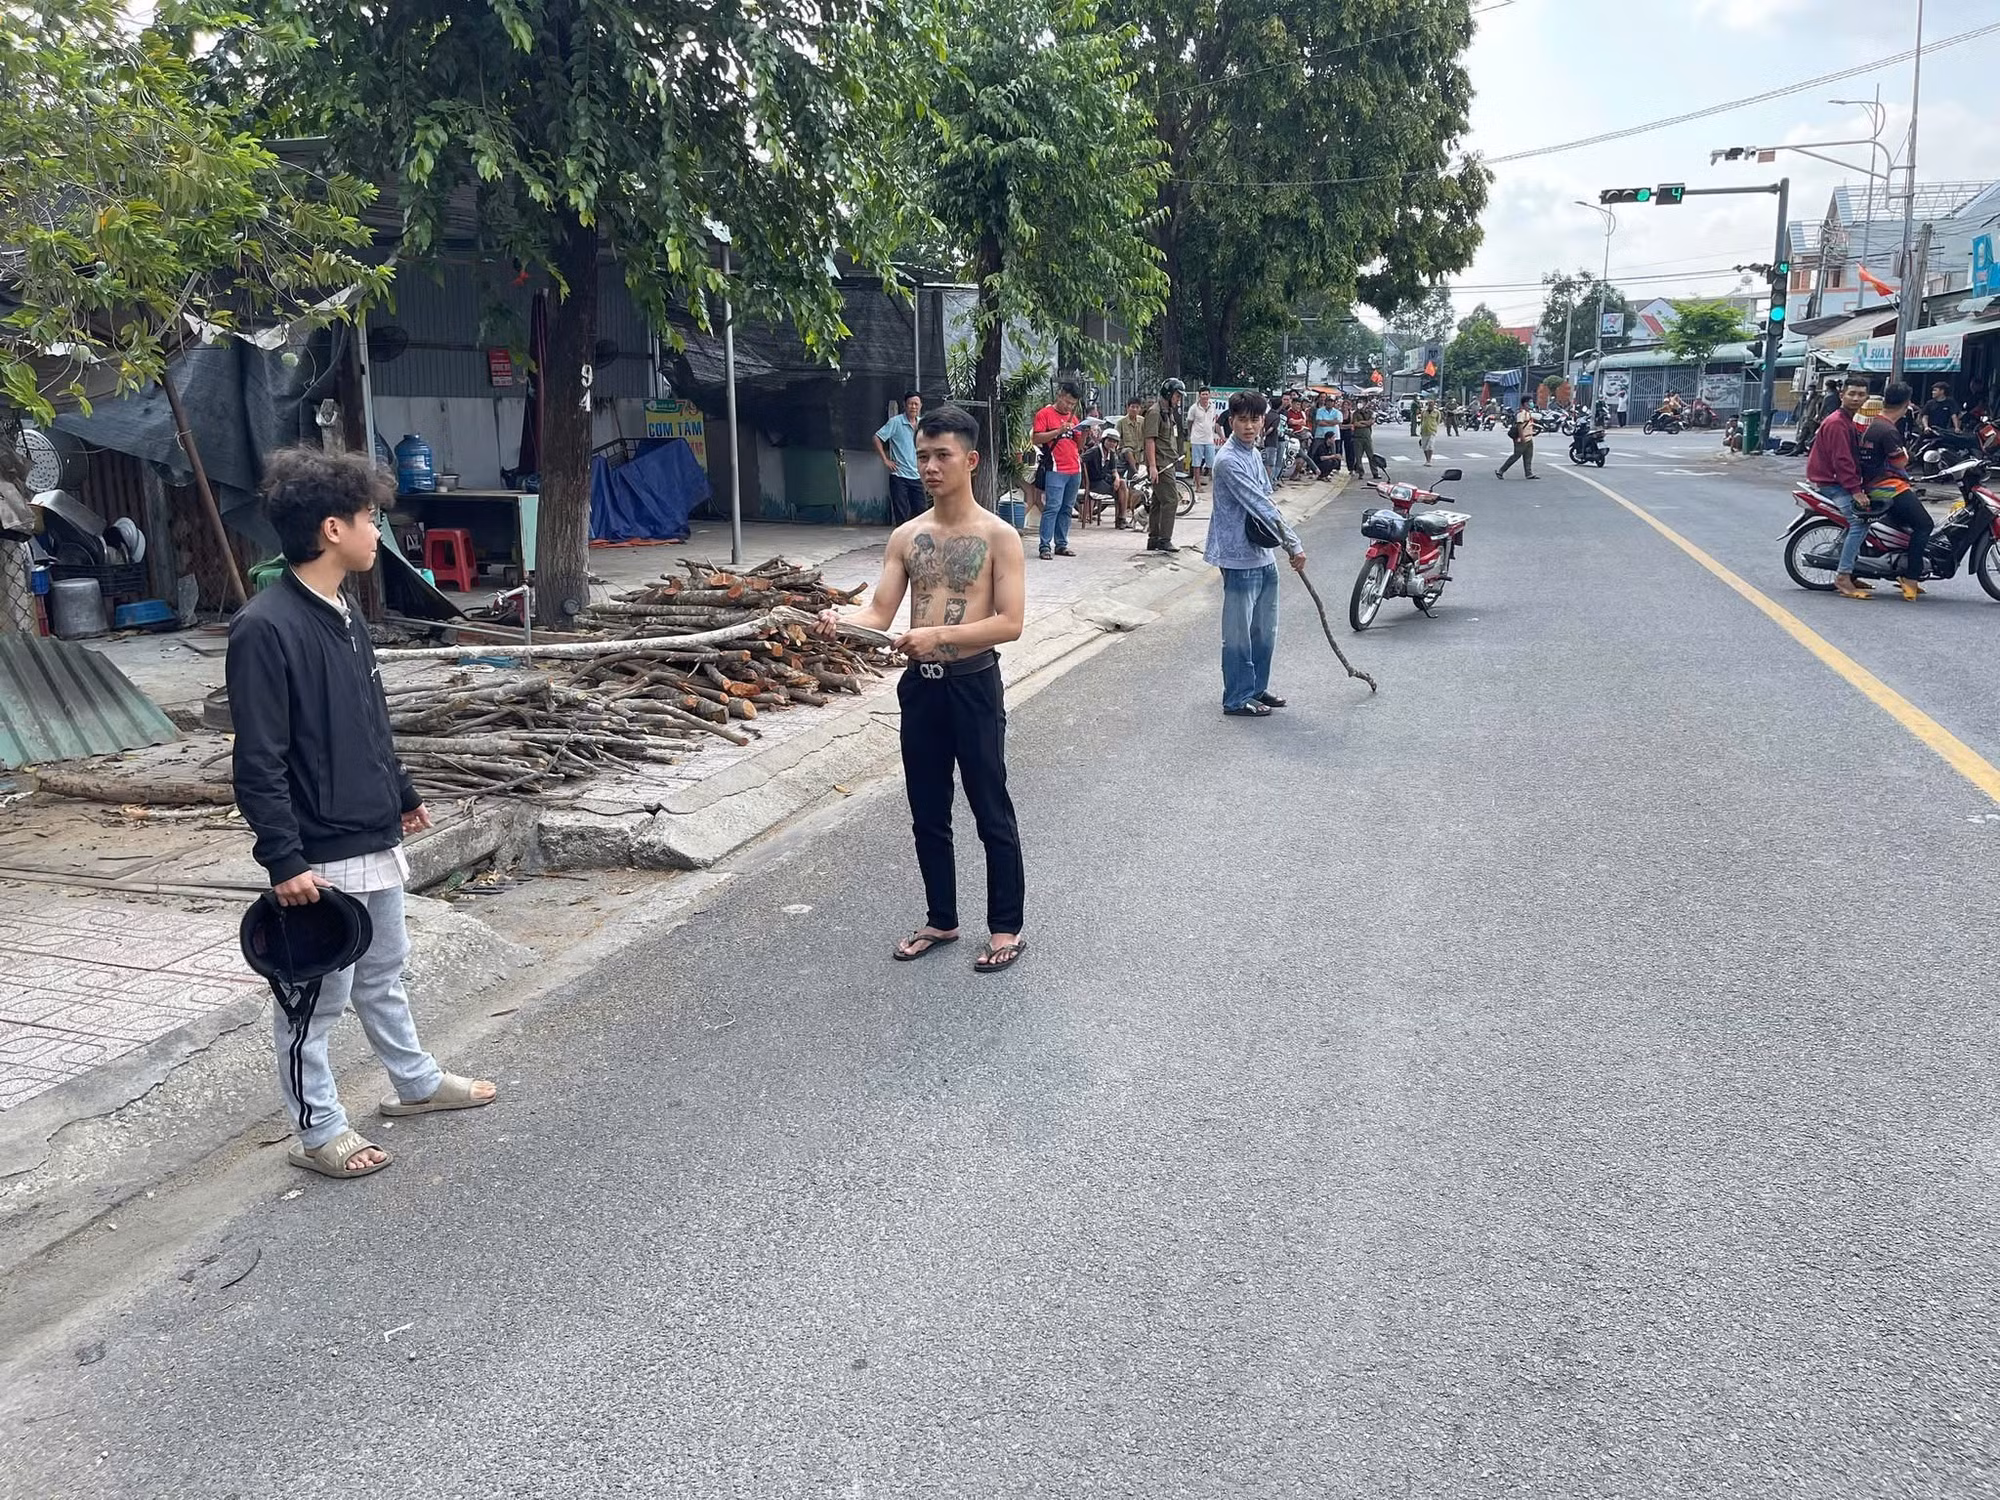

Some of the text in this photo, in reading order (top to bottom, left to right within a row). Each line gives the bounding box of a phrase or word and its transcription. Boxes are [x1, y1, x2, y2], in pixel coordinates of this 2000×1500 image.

[1672, 187, 1682, 201] 4
[1921, 344, 1950, 358] KHANG
[648, 418, 703, 437] CƠM TẤM
[336, 1134, 363, 1157] NIKE
